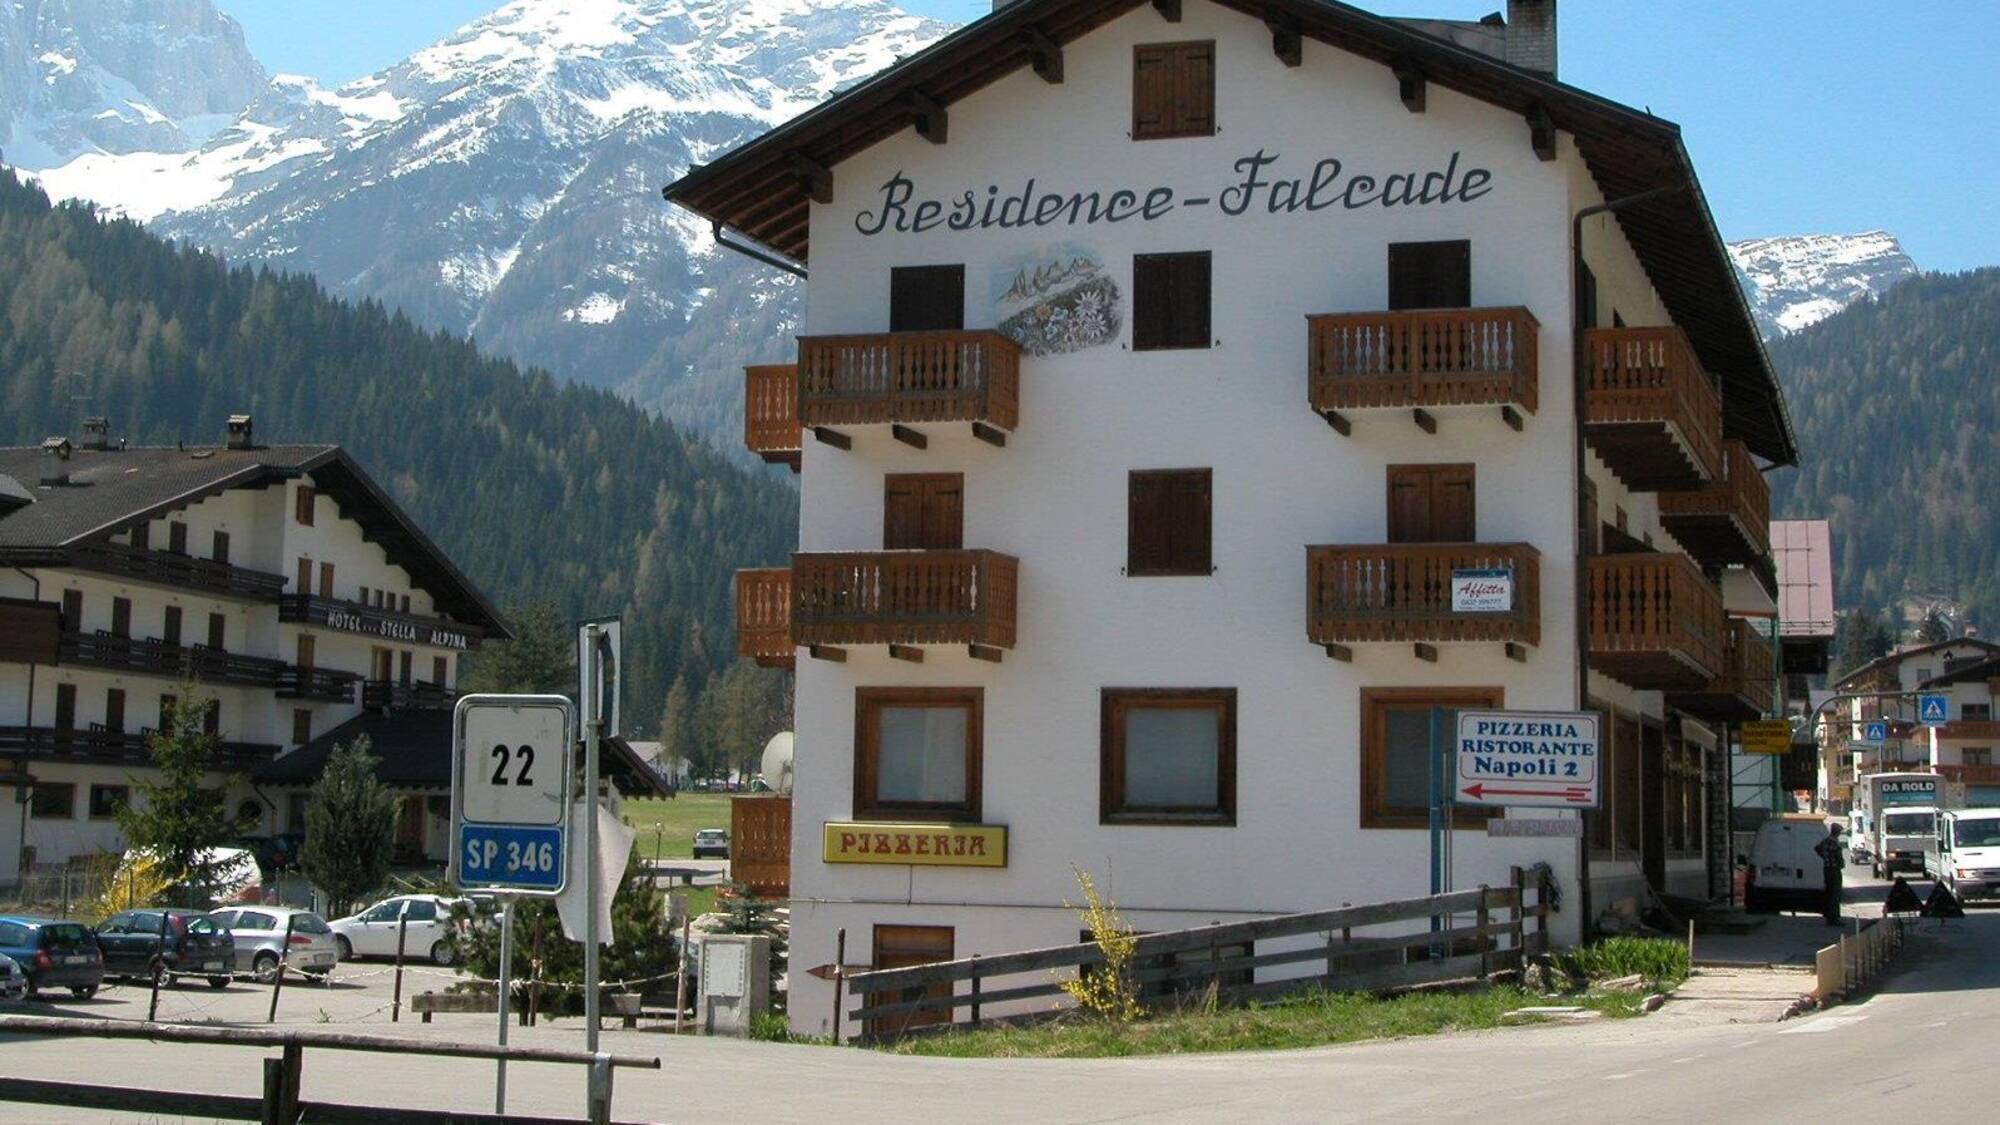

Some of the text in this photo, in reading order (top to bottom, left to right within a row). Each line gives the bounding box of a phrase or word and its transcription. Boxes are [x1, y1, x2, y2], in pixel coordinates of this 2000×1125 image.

[855, 170, 1175, 236] Residence
[1218, 148, 1494, 216] Falcade
[1457, 582, 1505, 598] Affitta
[327, 611, 467, 650] HOTEL STELLA ALPINA
[1477, 721, 1578, 738] PIZZERIA
[1461, 739, 1594, 756] RISTORANTE
[491, 744, 535, 786] 22
[1474, 757, 1578, 777] Napoli 2
[1881, 782, 1935, 792] DA ROLD
[467, 838, 554, 872] SP 346
[840, 832, 986, 857] PIZZERIA
